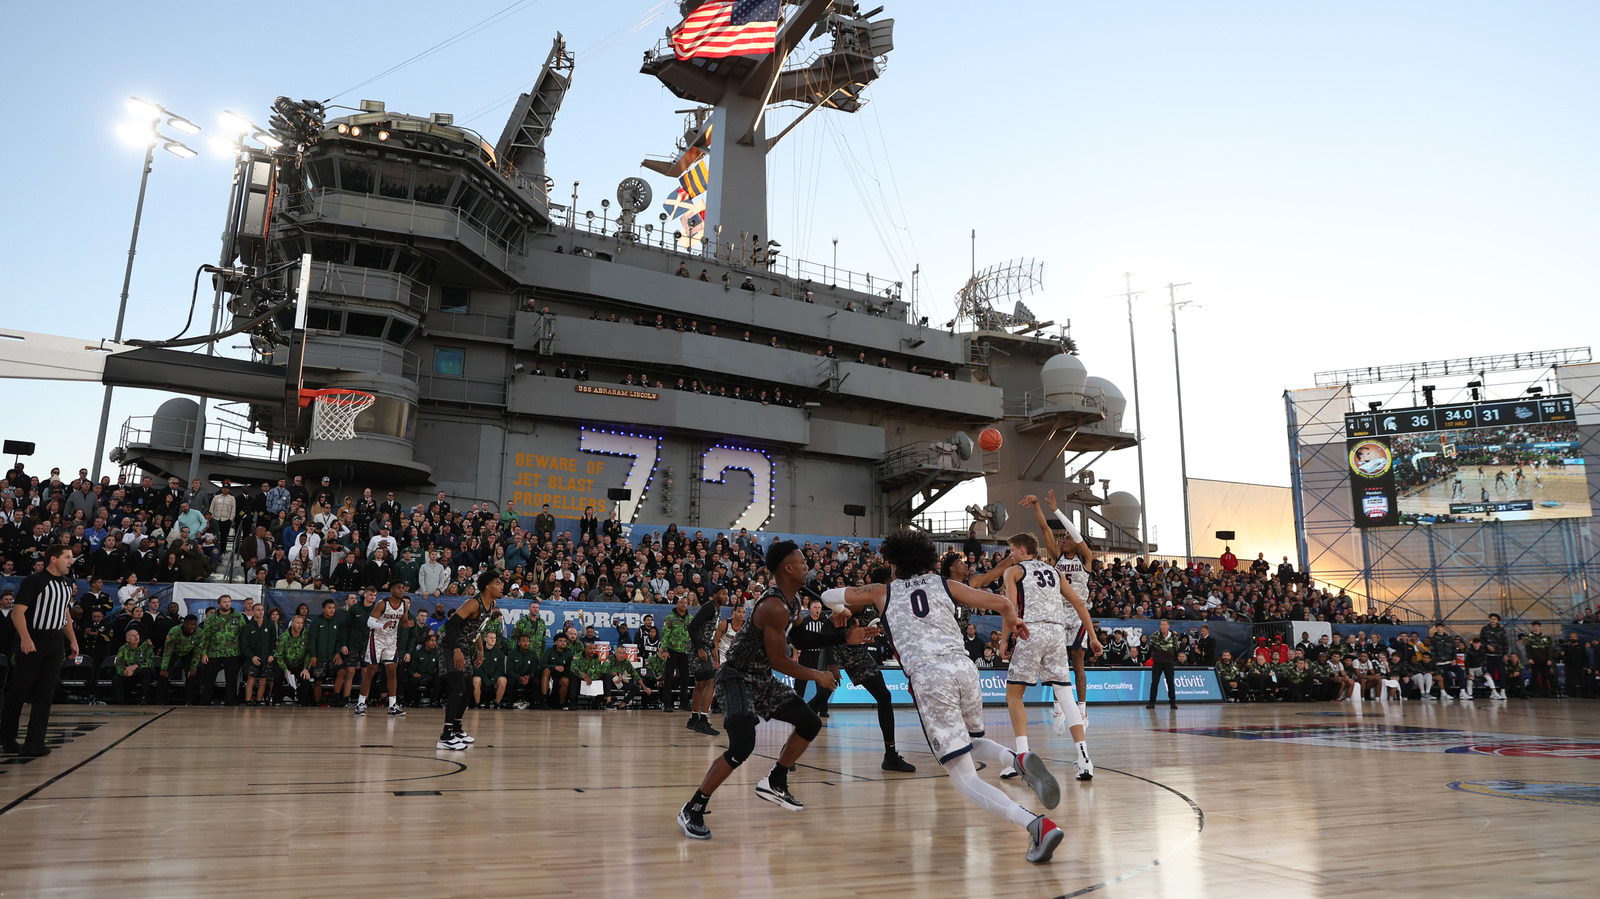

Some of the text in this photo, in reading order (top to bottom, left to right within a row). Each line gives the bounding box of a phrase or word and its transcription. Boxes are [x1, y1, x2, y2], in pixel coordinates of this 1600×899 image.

[578, 385, 657, 400] USS ABRAHAM LINCOLN
[1445, 409, 1473, 421] 34.0
[1482, 409, 1500, 421] 31
[1544, 406, 1556, 414] 10
[1411, 415, 1429, 428] 36
[515, 452, 605, 475] BEWARE OF
[513, 471, 595, 493] JET BLAST
[514, 491, 607, 513] PROPELLERS
[1056, 563, 1082, 572] GONZAGA
[1033, 569, 1056, 588] 33
[910, 588, 930, 619] 0
[1103, 682, 1134, 691] Consulting
